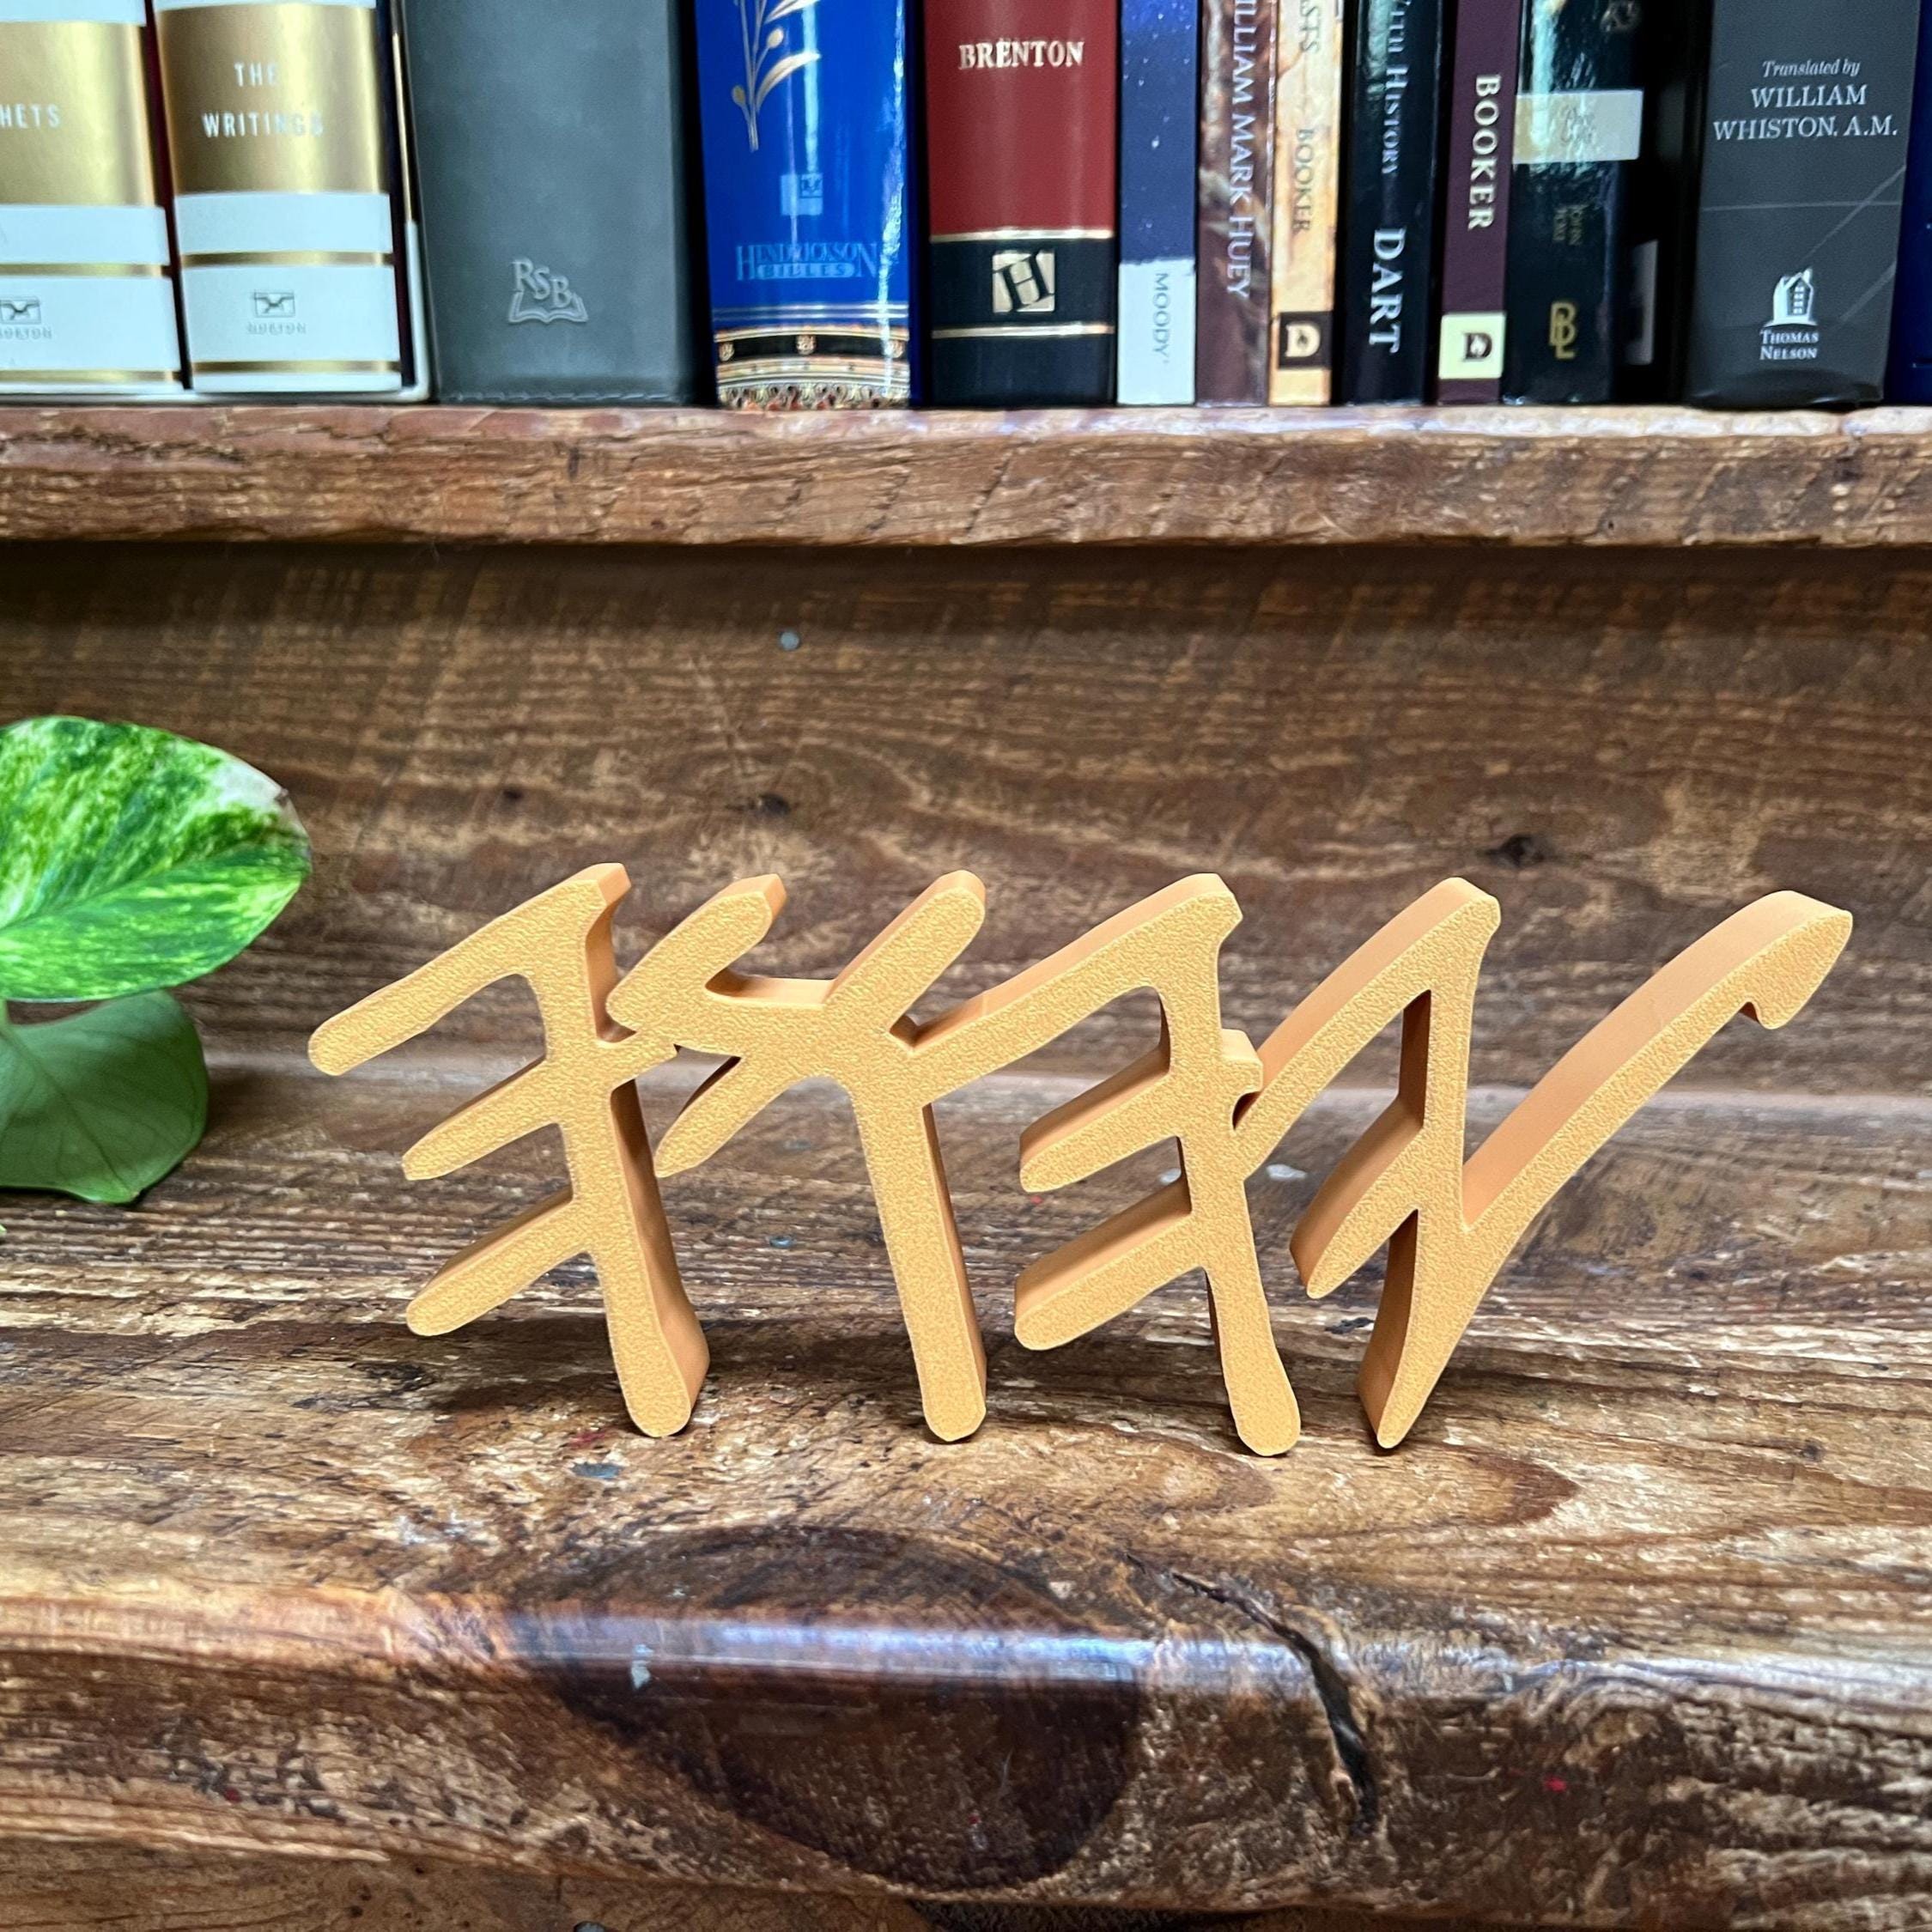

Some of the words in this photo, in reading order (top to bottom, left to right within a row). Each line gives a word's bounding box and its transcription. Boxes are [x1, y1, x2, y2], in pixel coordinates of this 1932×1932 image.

[1298, 0, 1321, 53] STS
[1387, 0, 1411, 52] ITH
[234, 63, 279, 87] THE
[958, 39, 1084, 70] BRENTON
[1762, 58, 1841, 77] Translated
[1842, 58, 1861, 76] by
[1751, 84, 1868, 108] WILLIAM
[202, 112, 325, 138] WRITINGS
[1382, 66, 1409, 174] HISTORY
[1843, 114, 1898, 137] A.M.
[1230, 113, 1256, 204] MARK
[1467, 74, 1502, 230] BOOKER
[1292, 129, 1315, 234] BOOKER
[736, 241, 878, 281] HENDRICKSON
[1226, 216, 1255, 299] HUEY
[511, 258, 574, 310] RSB
[1369, 227, 1406, 354] DART
[1759, 329, 1820, 344] THOMAS
[1759, 345, 1819, 361] NELSON
